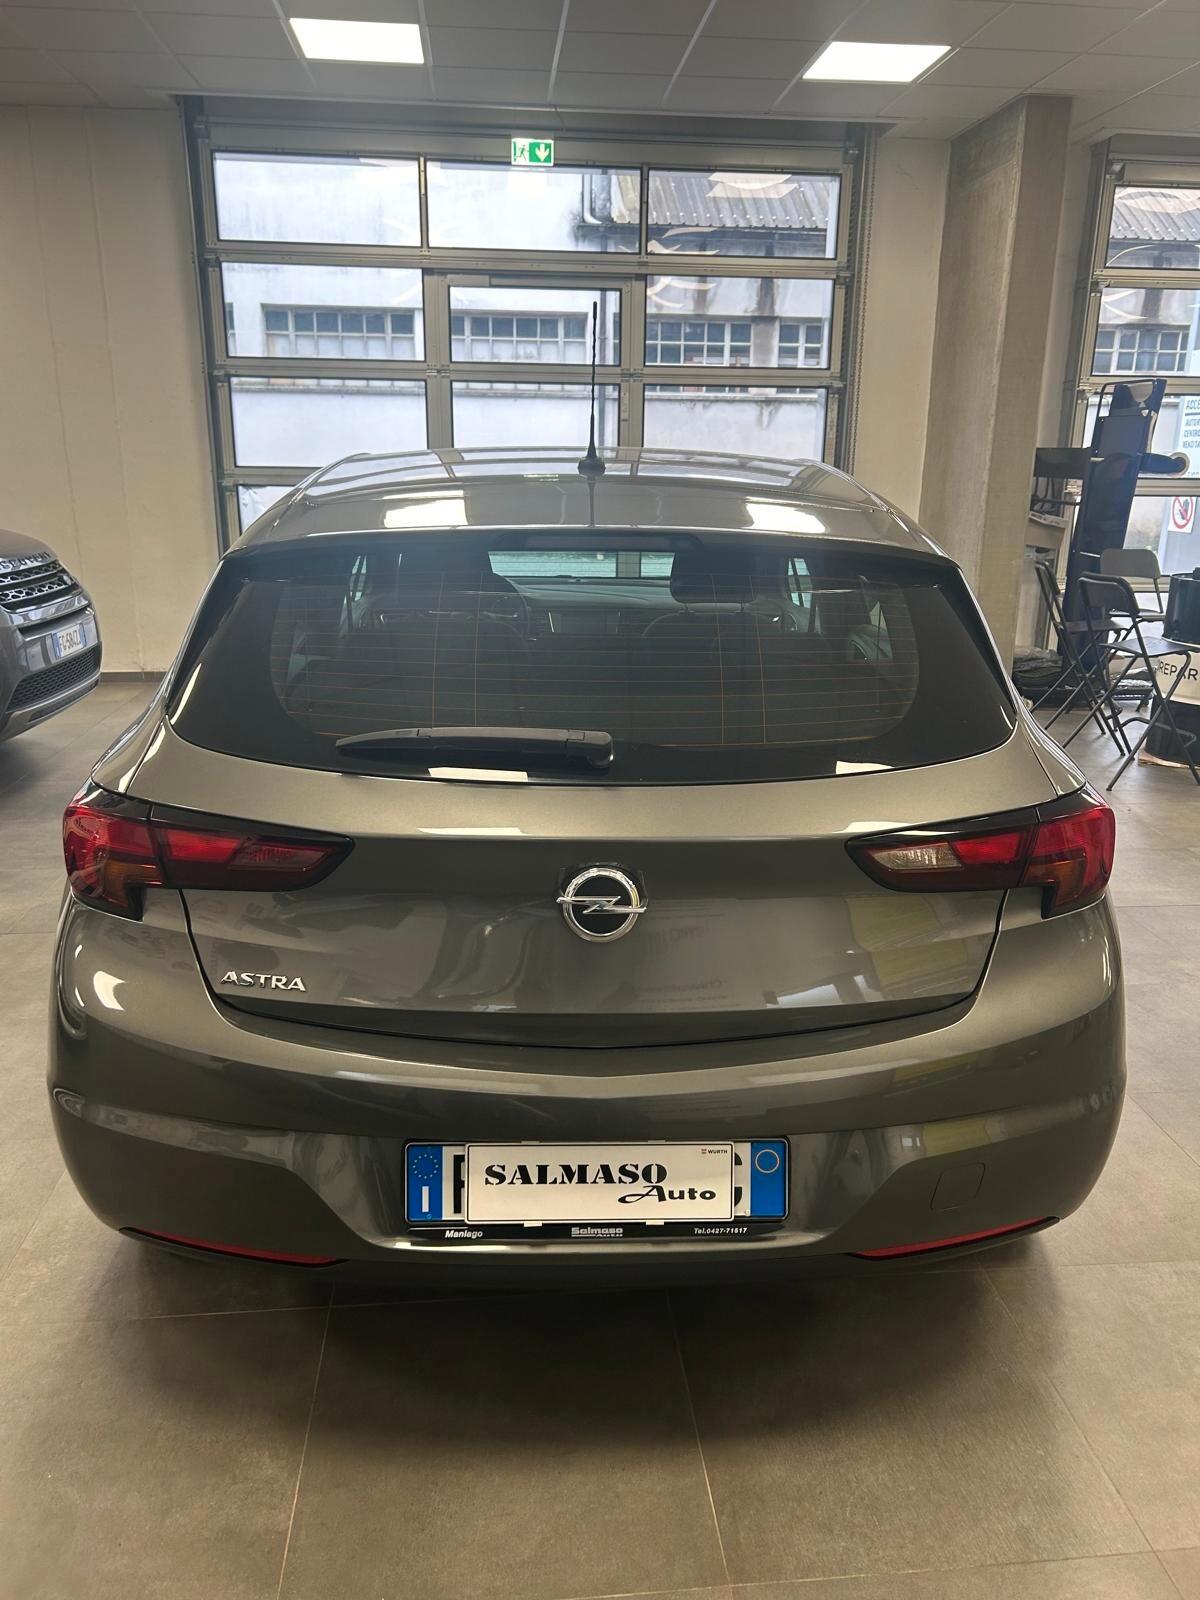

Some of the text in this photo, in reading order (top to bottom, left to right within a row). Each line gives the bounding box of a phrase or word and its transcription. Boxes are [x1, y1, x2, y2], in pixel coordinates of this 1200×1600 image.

[219, 970, 307, 992] ASTRA
[484, 1163, 668, 1186] SALMASO
[617, 1185, 717, 1204] Auto
[444, 1229, 484, 1240] Maniago
[571, 1226, 624, 1235] Salmaso
